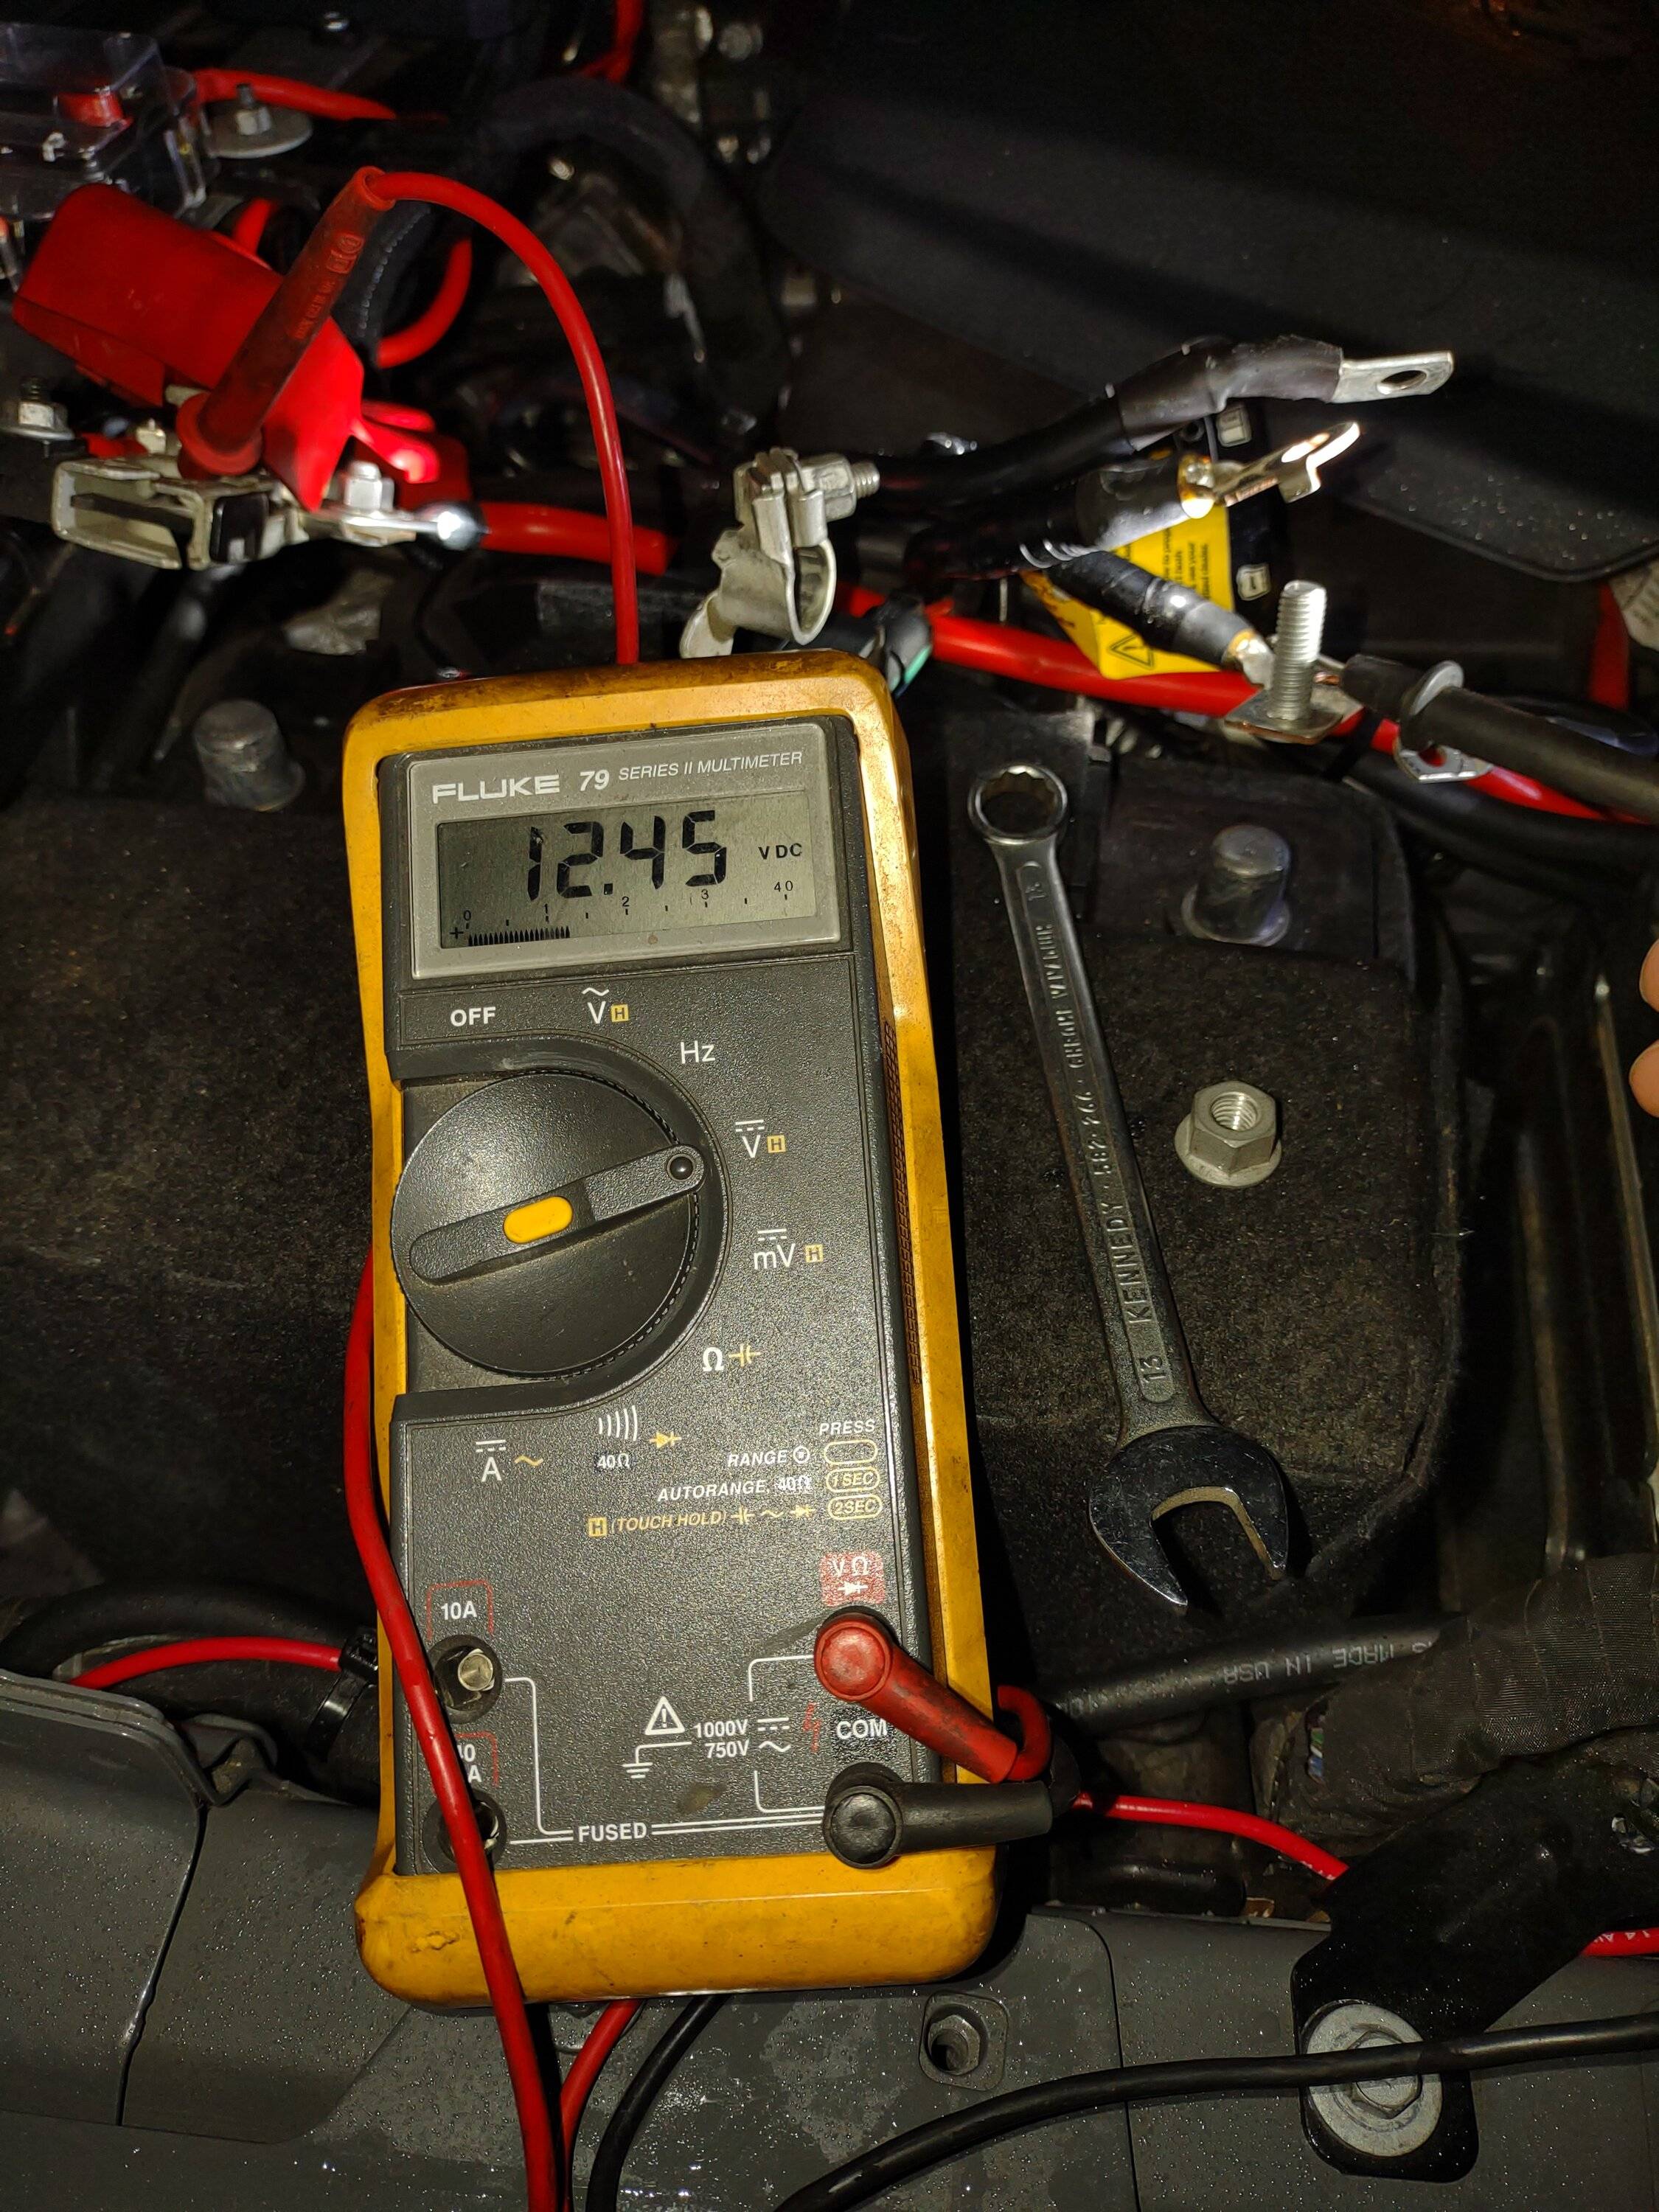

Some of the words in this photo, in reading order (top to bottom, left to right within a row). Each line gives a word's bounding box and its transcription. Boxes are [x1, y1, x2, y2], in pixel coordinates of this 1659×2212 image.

[431, 774, 560, 804] FLUKE
[580, 770, 610, 792] 79
[618, 762, 679, 782] SERIES
[684, 761, 693, 776] II
[697, 751, 803, 774] MULTIMETER
[527, 810, 727, 901] 12.45
[622, 895, 630, 908] 2
[701, 888, 709, 900] 3
[451, 1006, 496, 1027] OFF
[613, 1006, 627, 1020] H
[680, 1040, 716, 1064] Hz
[742, 1135, 761, 1158] V
[769, 1136, 784, 1151] H
[754, 1243, 796, 1270] mV
[807, 1246, 822, 1261] H
[1100, 1202, 1152, 1324] KENNEDY
[1140, 1353, 1166, 1384] 13
[819, 1419, 876, 1436] PRESS
[481, 1456, 503, 1483] A
[726, 1449, 787, 1467] RANGE
[657, 1478, 771, 1502] AUTORANGE,
[611, 1514, 677, 1534] (TOUCH
[677, 1511, 727, 1528] HOLD)
[440, 1600, 478, 1621] 10A
[1222, 1660, 1270, 1686] USA
[1285, 1654, 1312, 1677] IN
[692, 1719, 749, 1739] 1000V
[836, 1718, 887, 1740] COM
[704, 1739, 751, 1759] 750V
[578, 1821, 647, 1843] FUSED
